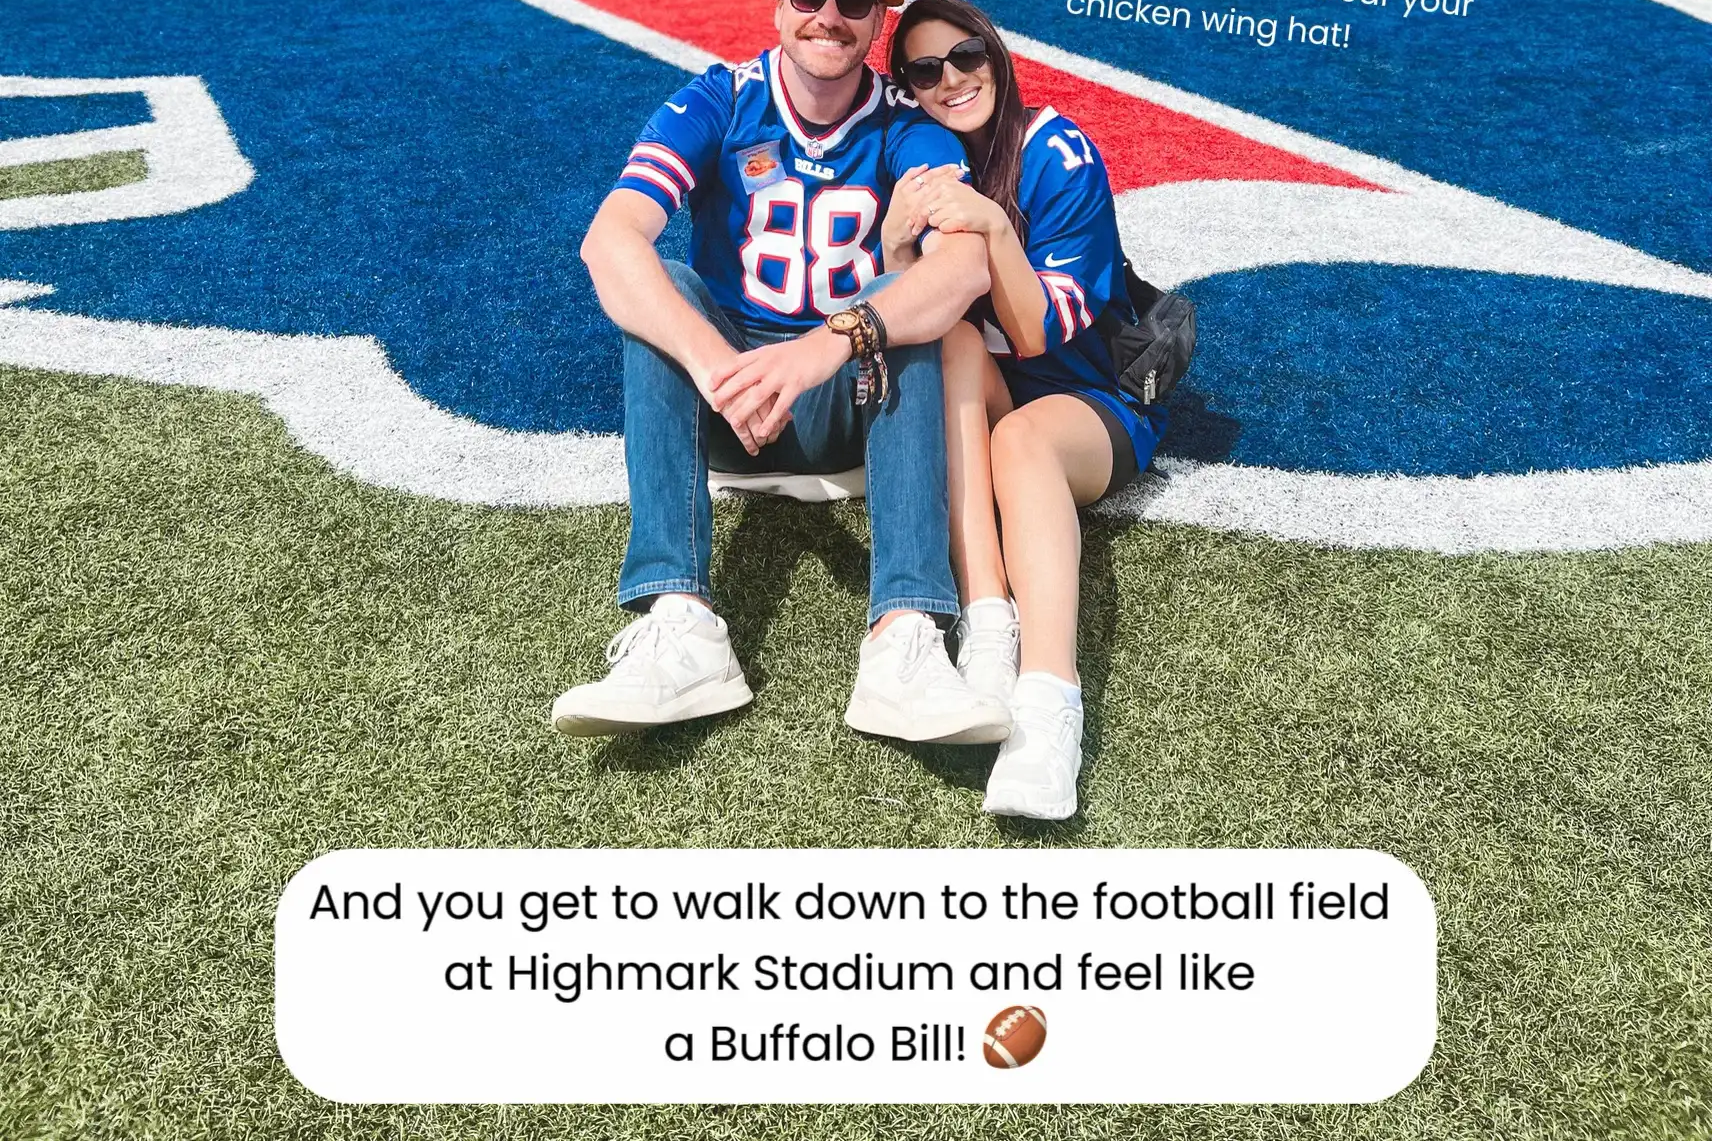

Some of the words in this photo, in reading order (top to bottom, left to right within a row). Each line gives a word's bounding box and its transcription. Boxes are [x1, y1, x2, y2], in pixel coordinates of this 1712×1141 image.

[794, 157, 836, 181] BILLS
[1046, 129, 1095, 171] 17
[738, 176, 881, 317] 88
